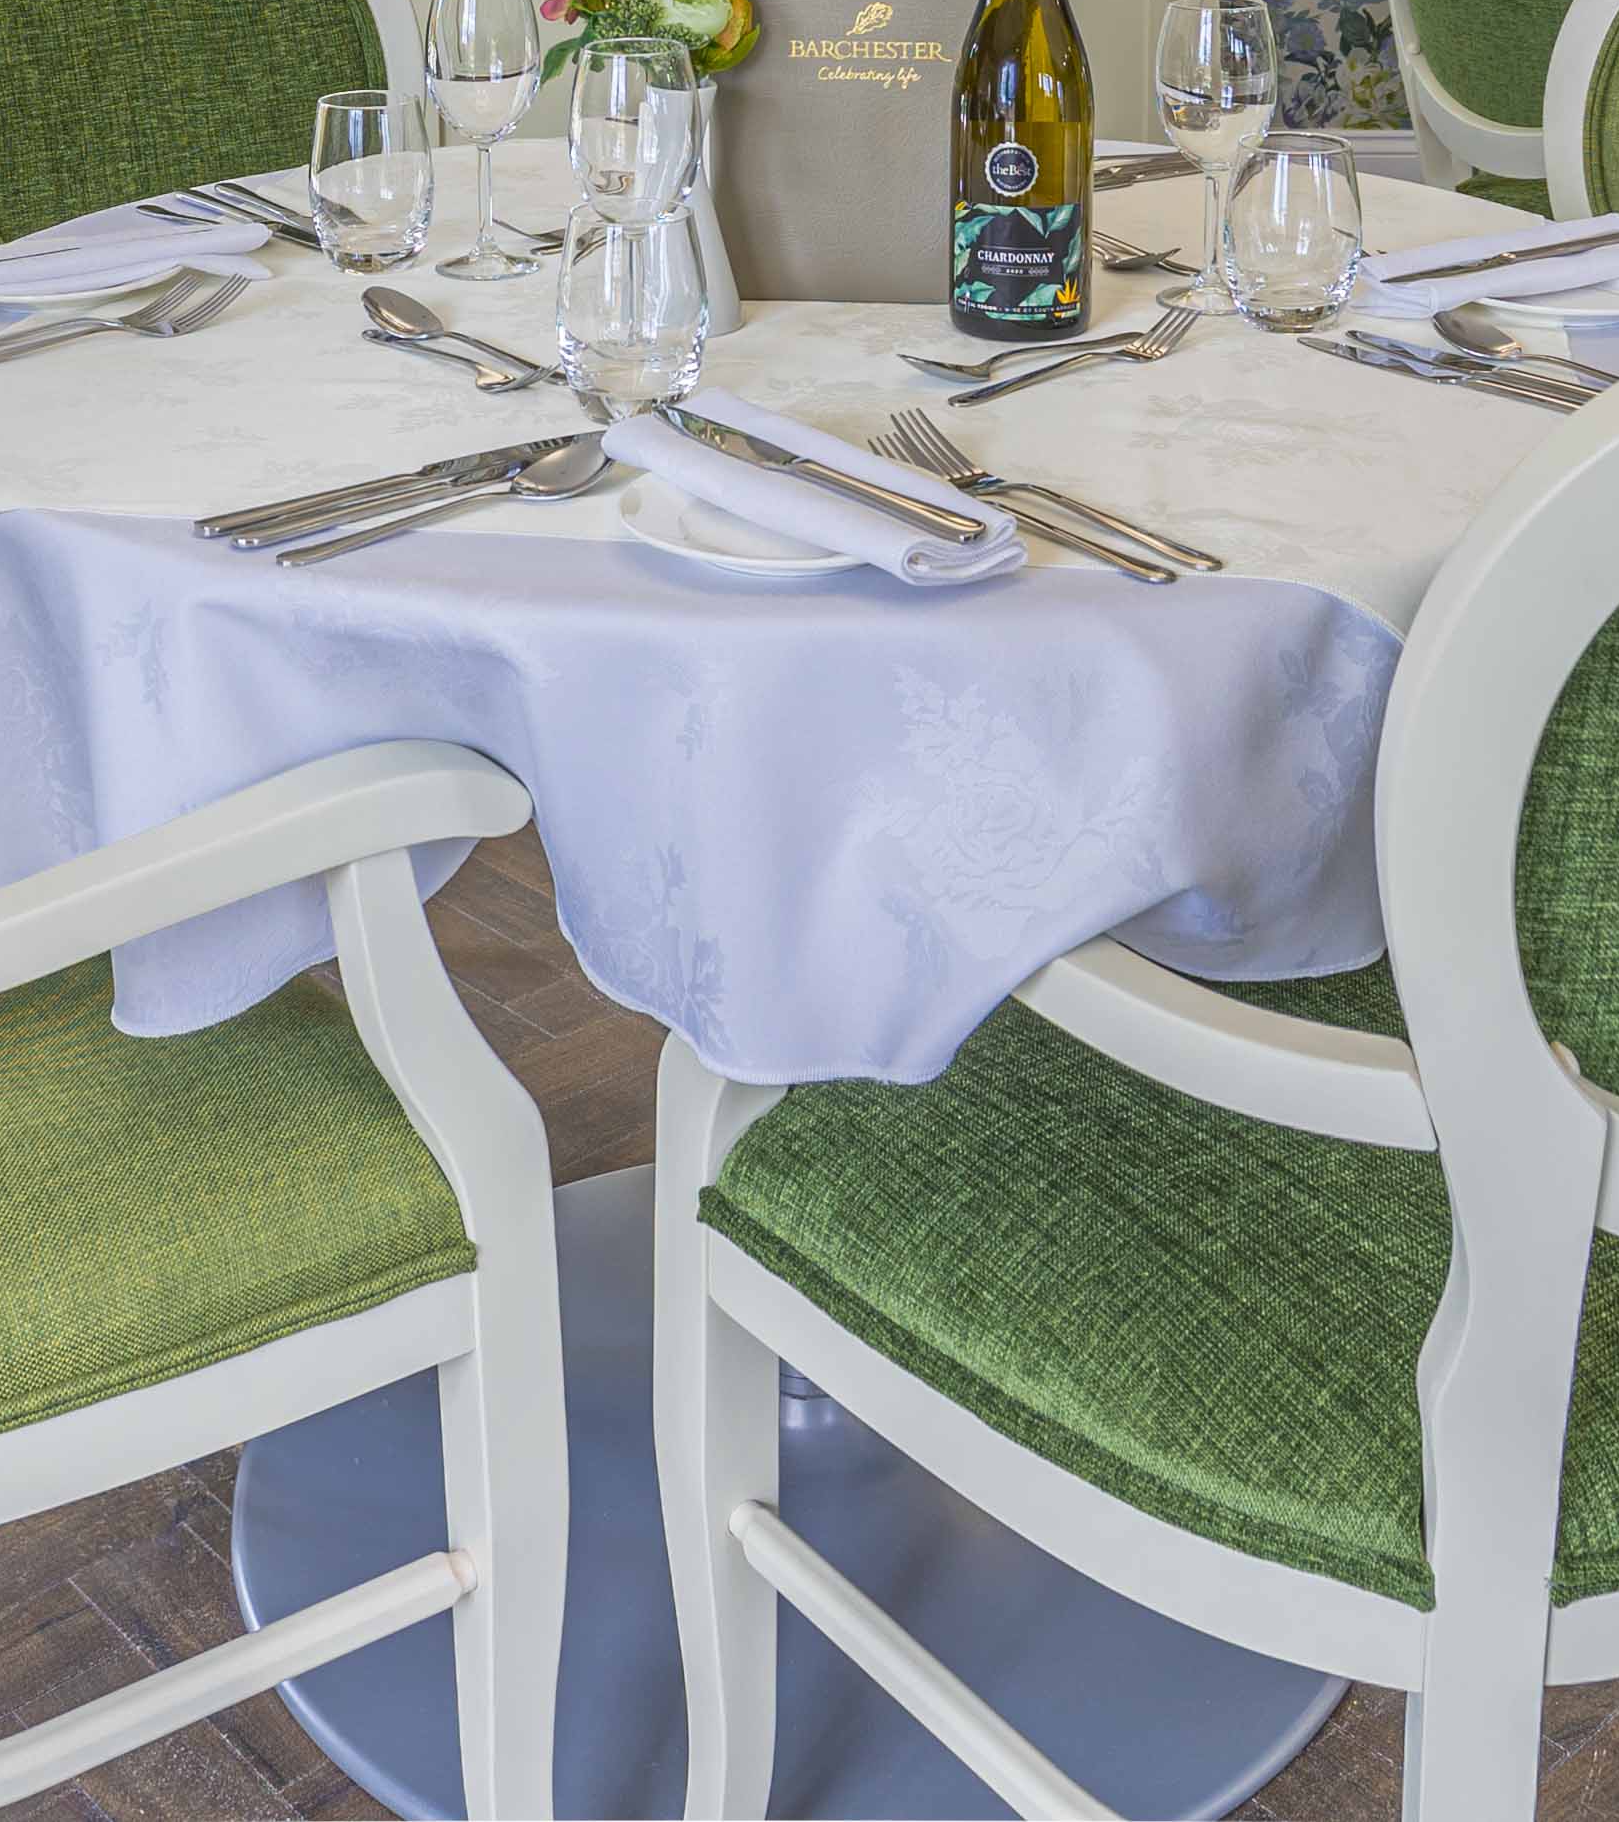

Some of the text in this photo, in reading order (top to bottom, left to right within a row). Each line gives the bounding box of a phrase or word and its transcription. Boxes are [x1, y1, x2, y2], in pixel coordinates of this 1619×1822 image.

[788, 39, 953, 62] BARCHESTER
[817, 66, 923, 90] Celebrating life
[977, 249, 1055, 264] CHARDONNAY
